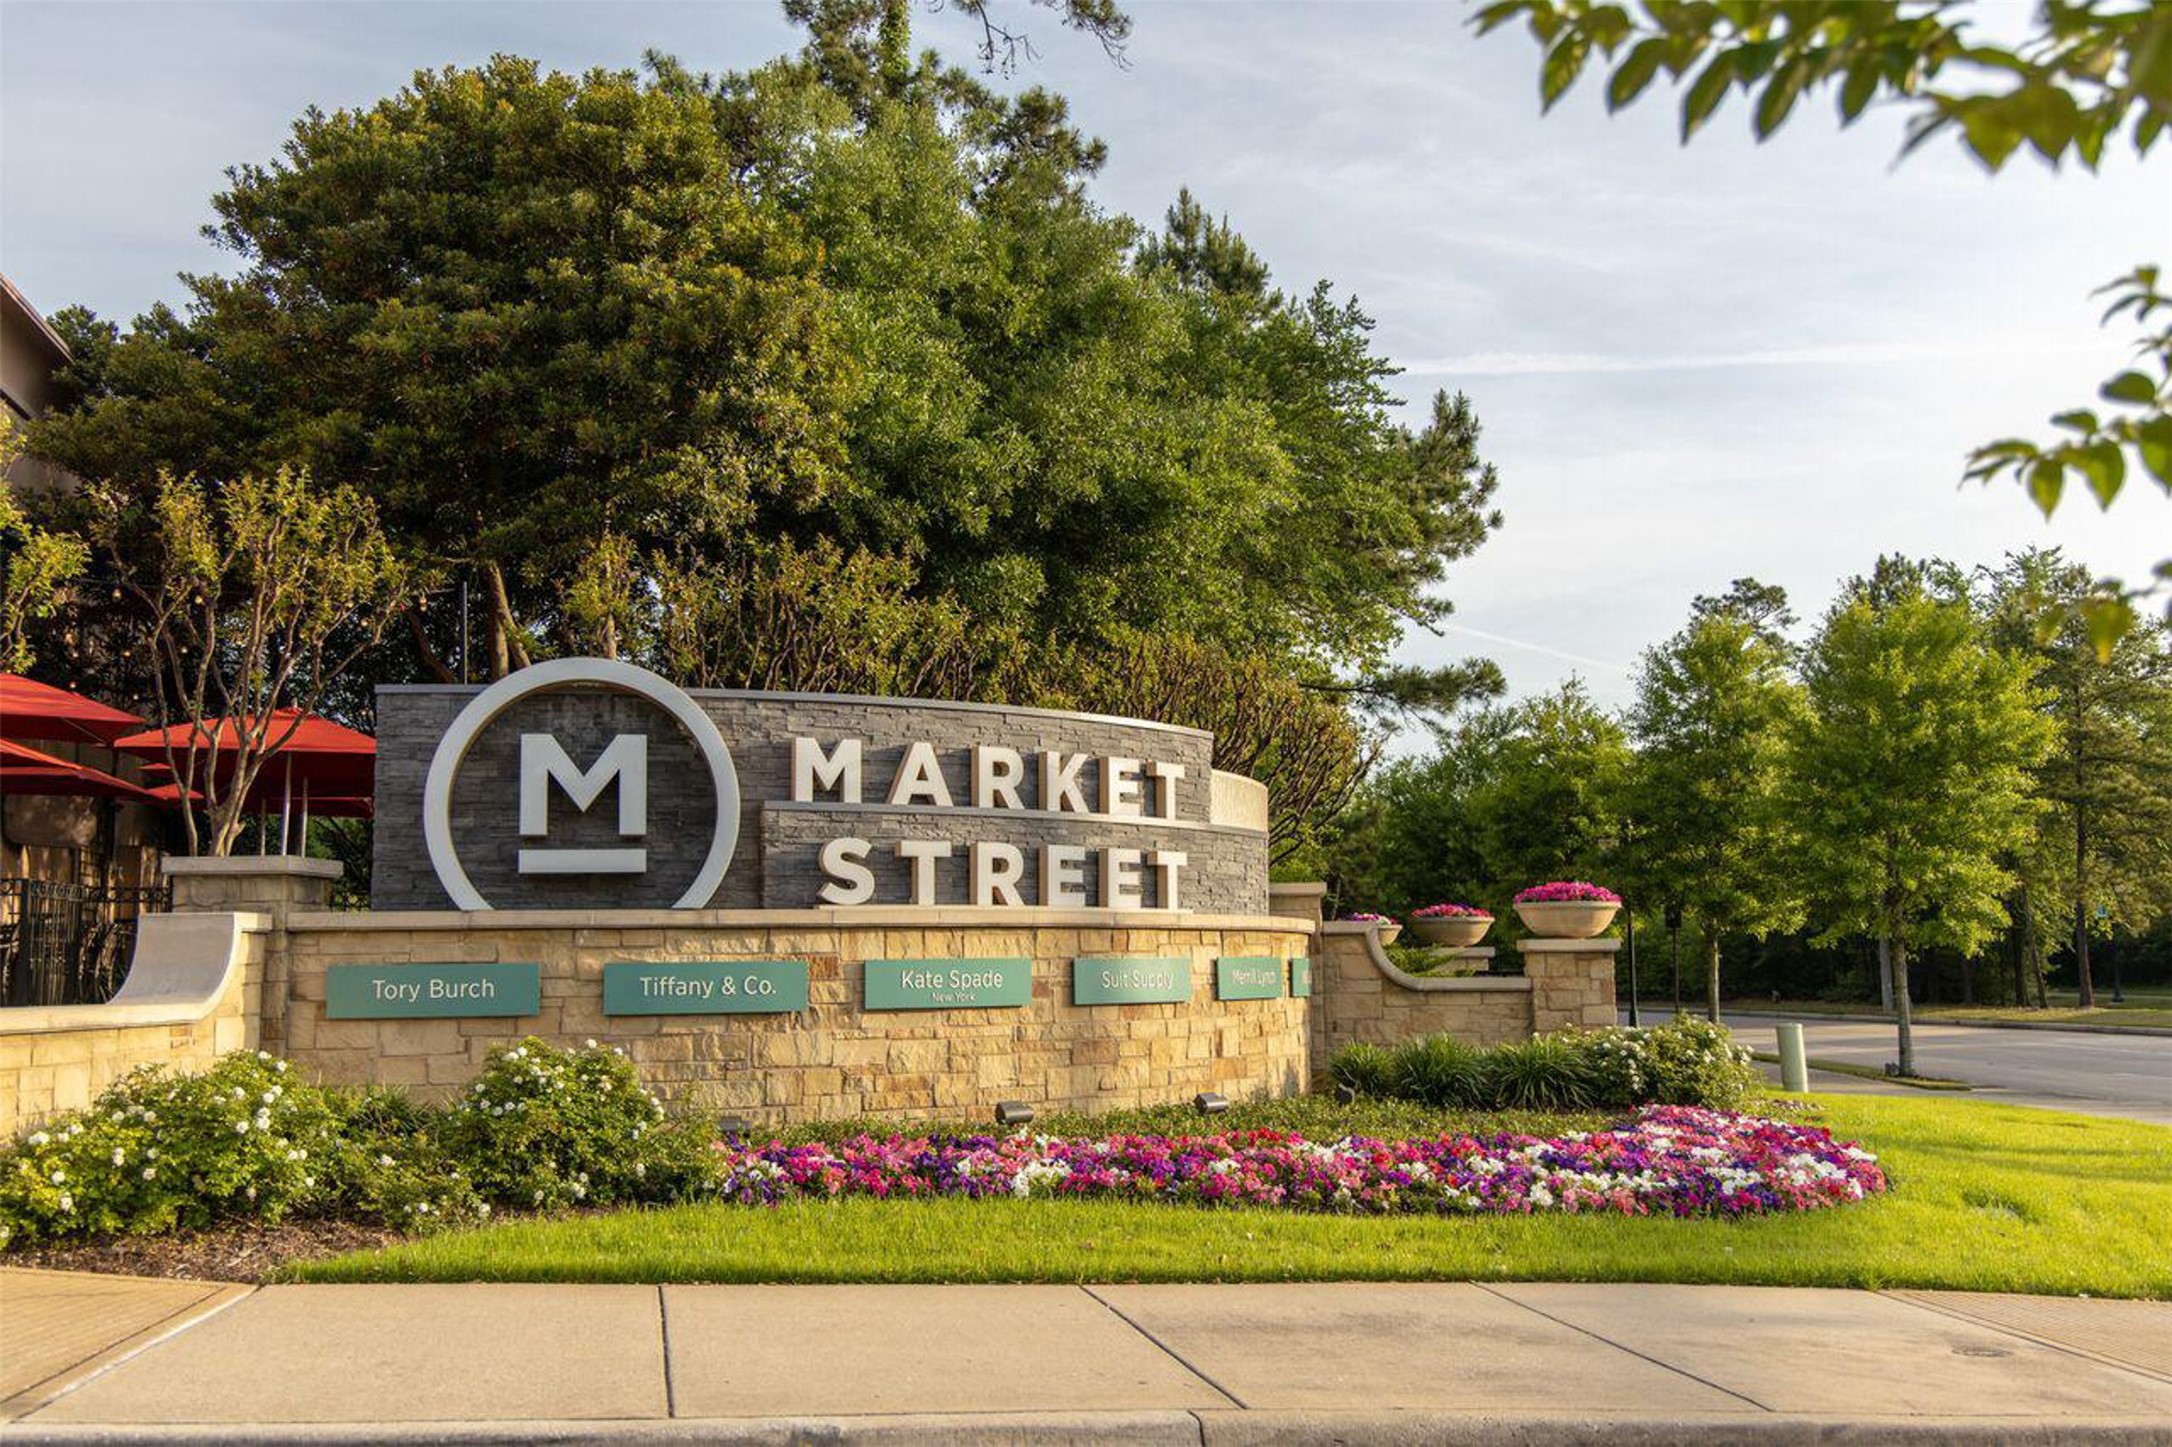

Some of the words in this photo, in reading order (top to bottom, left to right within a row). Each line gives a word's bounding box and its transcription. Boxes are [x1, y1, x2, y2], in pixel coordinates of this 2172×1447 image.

[519, 733, 648, 837] M
[791, 737, 1186, 820] MARKET
[818, 837, 1188, 911] STREET
[372, 979, 421, 1003] Tory
[429, 978, 495, 999] Burch
[639, 976, 714, 999] Tiffany
[721, 976, 736, 996] &
[744, 975, 777, 995] Co.
[901, 969, 943, 989] Kate
[949, 969, 1004, 991] Spade
[1102, 970, 1128, 989] Suit
[1132, 969, 1174, 991] Supply
[932, 992, 953, 1002] New
[954, 991, 977, 1002] York
